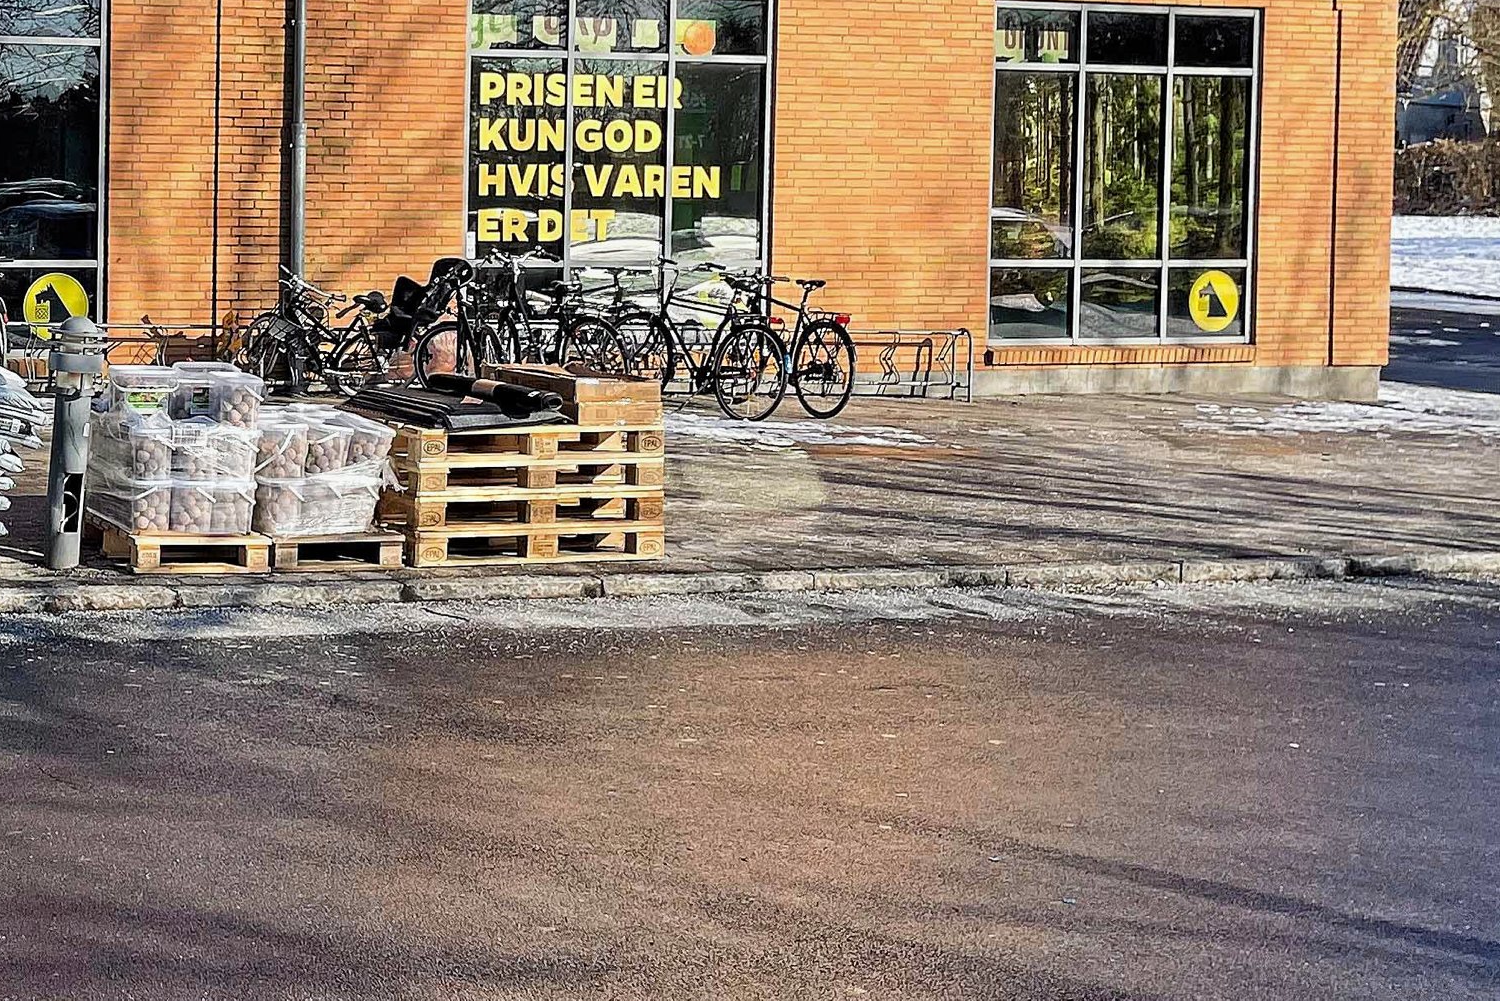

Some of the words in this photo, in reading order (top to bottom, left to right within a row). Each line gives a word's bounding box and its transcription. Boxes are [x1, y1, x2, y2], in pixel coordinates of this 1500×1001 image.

[479, 72, 624, 107] PRISEN
[634, 76, 683, 110] ER
[478, 118, 565, 151] KUN
[575, 119, 662, 153] GOD
[478, 163, 574, 197] HVIS
[583, 164, 721, 199] VAREN
[477, 208, 529, 242] ER
[537, 209, 616, 242] DET
[425, 442, 442, 454] EPAL
[643, 438, 661, 449] EPAL
